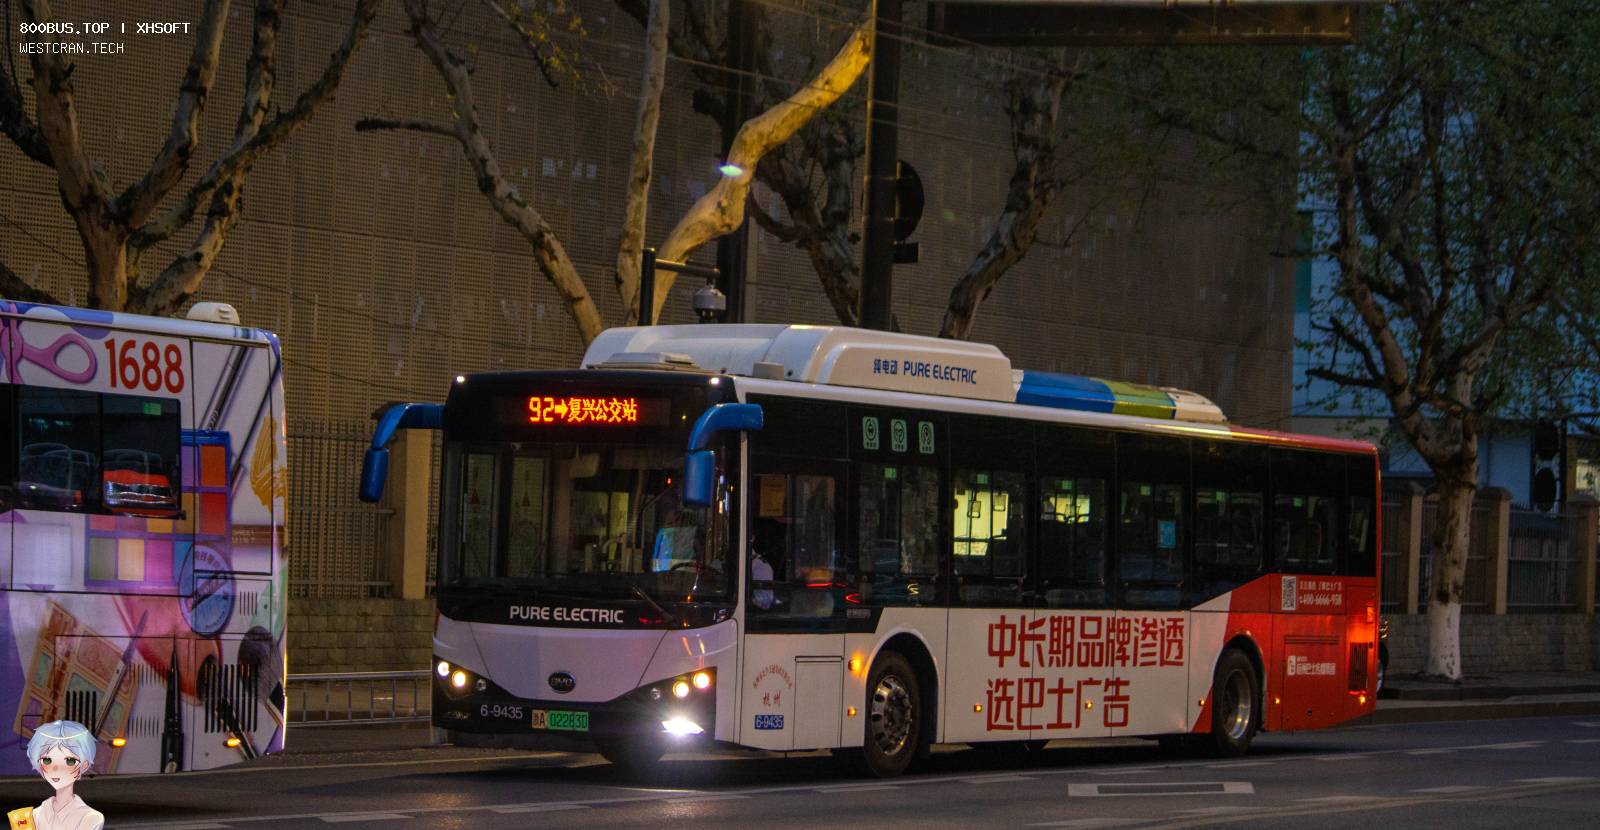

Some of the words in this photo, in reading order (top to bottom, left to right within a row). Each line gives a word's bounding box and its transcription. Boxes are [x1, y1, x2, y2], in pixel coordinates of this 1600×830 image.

[104, 338, 184, 394] 1688
[903, 361, 930, 378] PURE
[933, 365, 977, 384] ELECTRIC
[529, 397, 554, 422] 92
[567, 397, 637, 422] 复兴公交站
[509, 605, 550, 620] PURE
[553, 608, 624, 623] ELECTRIC
[987, 614, 1185, 668] 中长期品牌渗透
[480, 704, 523, 719] 6-9435
[986, 677, 1130, 731] 选巴士广告
